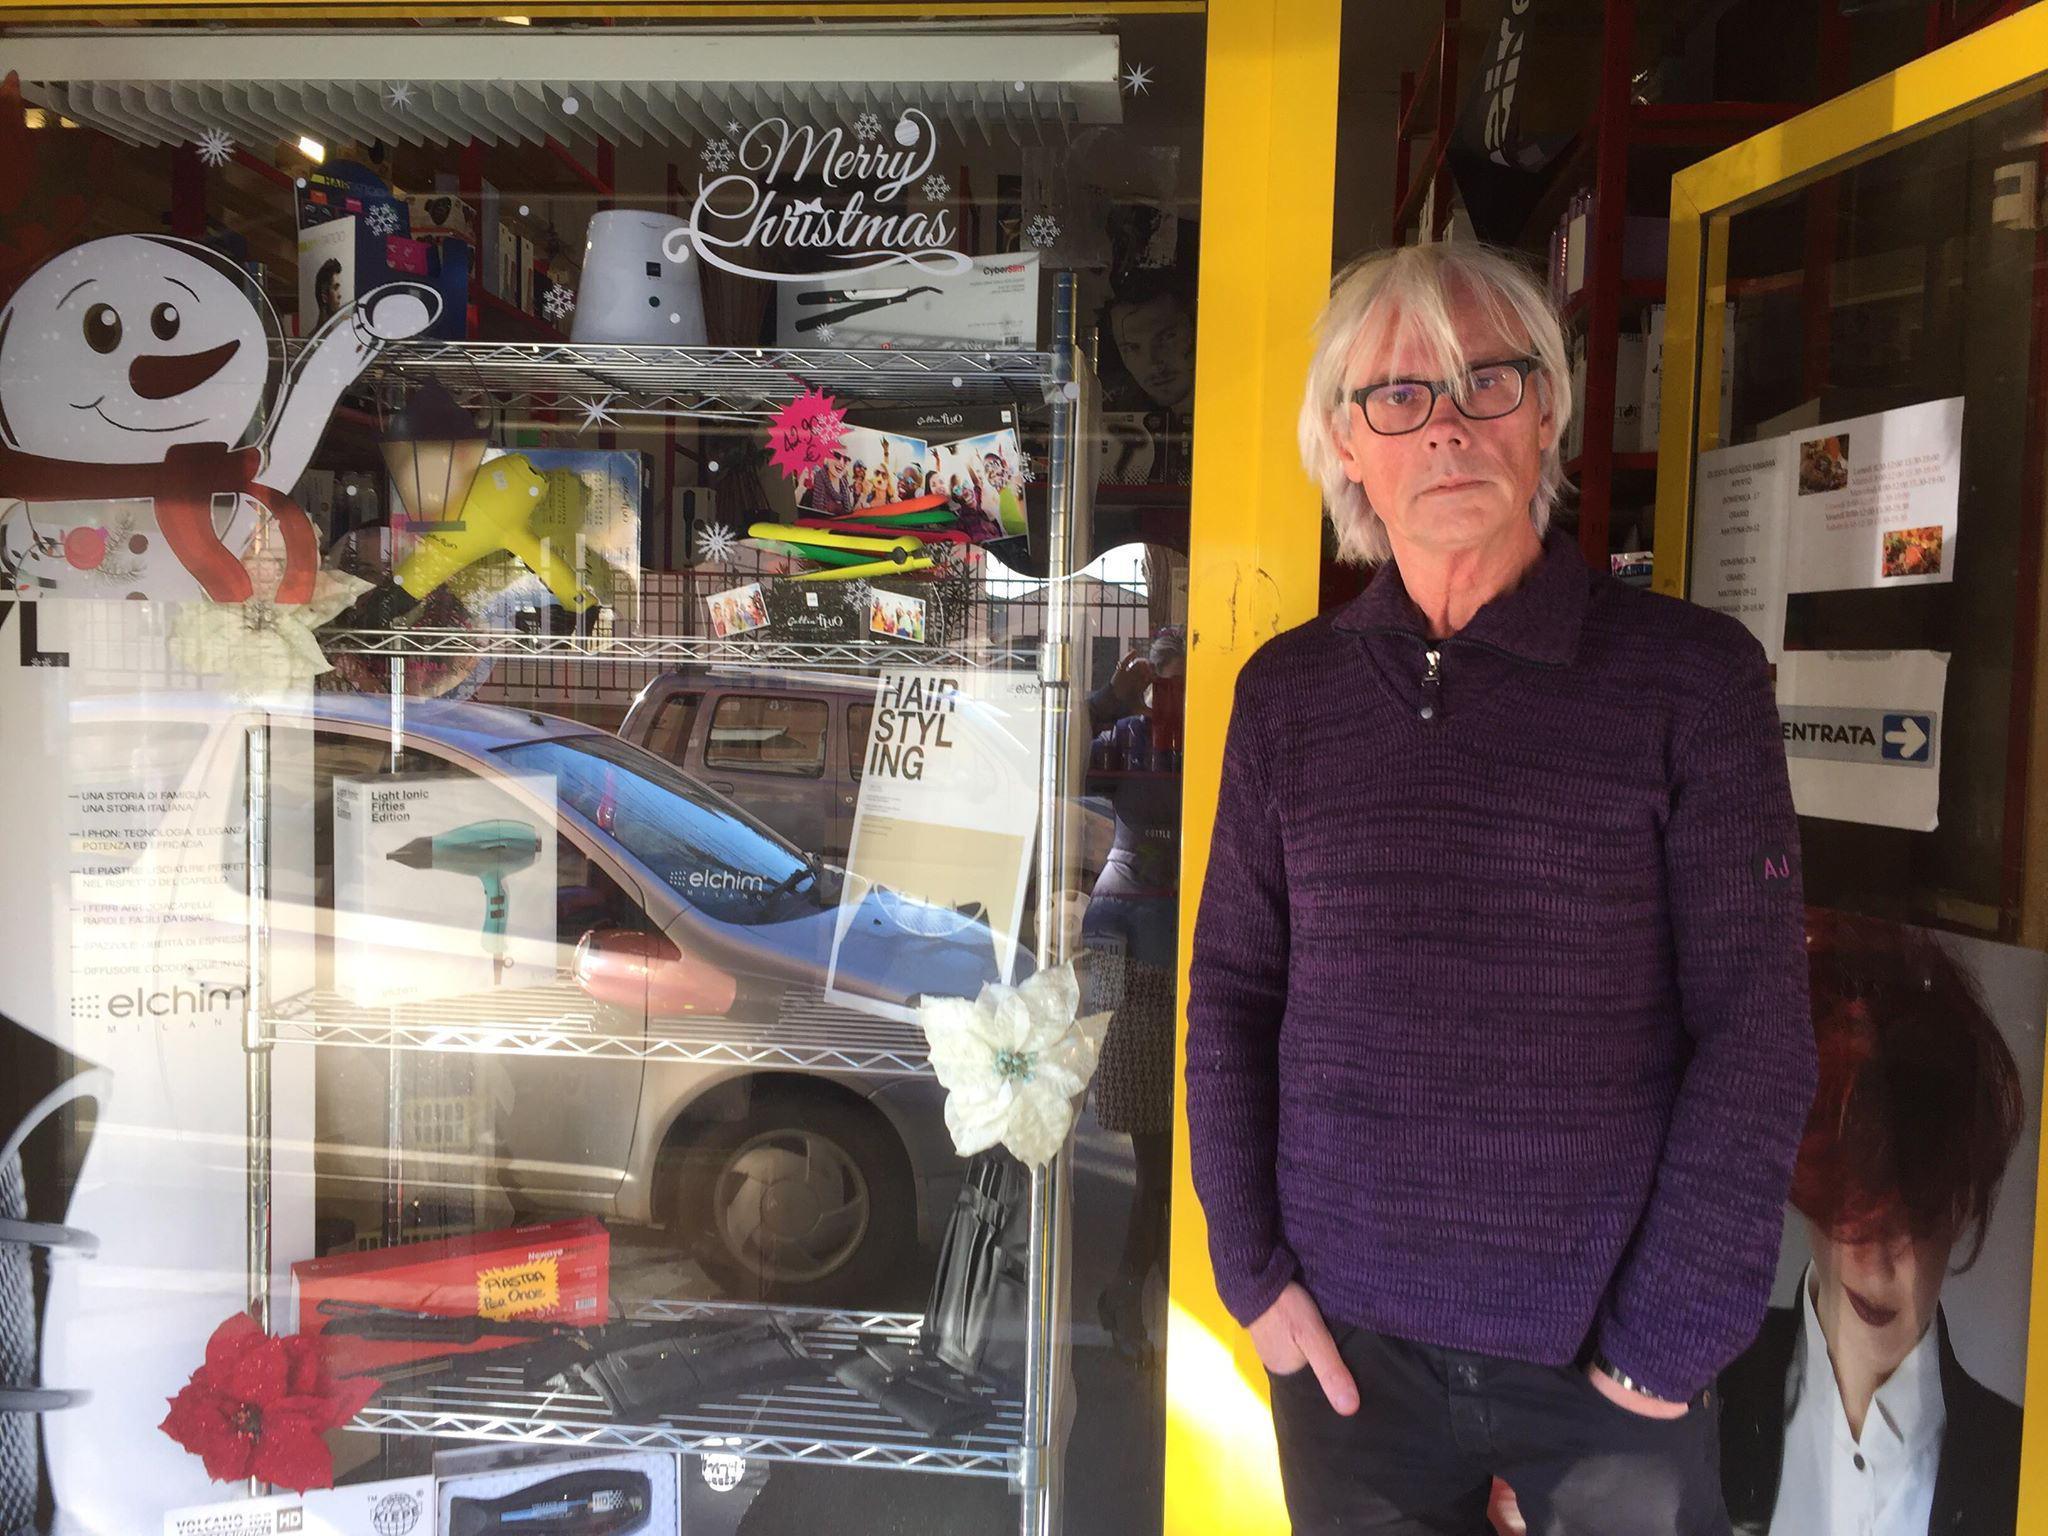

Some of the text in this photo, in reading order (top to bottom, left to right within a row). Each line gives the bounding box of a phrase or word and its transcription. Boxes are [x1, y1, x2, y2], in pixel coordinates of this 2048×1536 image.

[739, 108, 936, 203] Merry
[672, 173, 960, 262] Christmas
[983, 265, 1025, 276] CyberSlim
[881, 675, 959, 713] HAIR
[875, 708, 953, 749] STYL
[1782, 722, 1876, 746] ENTRATA
[869, 743, 925, 781] ING
[82, 792, 104, 801] UNA
[106, 792, 145, 801] STORIA
[147, 792, 157, 800] DI
[372, 790, 429, 803] Light Ionic
[82, 804, 104, 813] UNA
[106, 804, 145, 813] STORIA
[372, 802, 406, 812] Fifties
[372, 813, 411, 822] Edition
[82, 841, 131, 851] POTENZA
[133, 841, 147, 850] ED
[82, 866, 98, 875] LE
[1765, 854, 1790, 880] AJ
[689, 869, 764, 891] elchim
[163, 914, 177, 924] DA
[108, 985, 248, 1018] elchim
[107, 1018, 240, 1033] MILAN
[279, 1511, 301, 1531] HD
[373, 1506, 420, 1523] KIEPE
